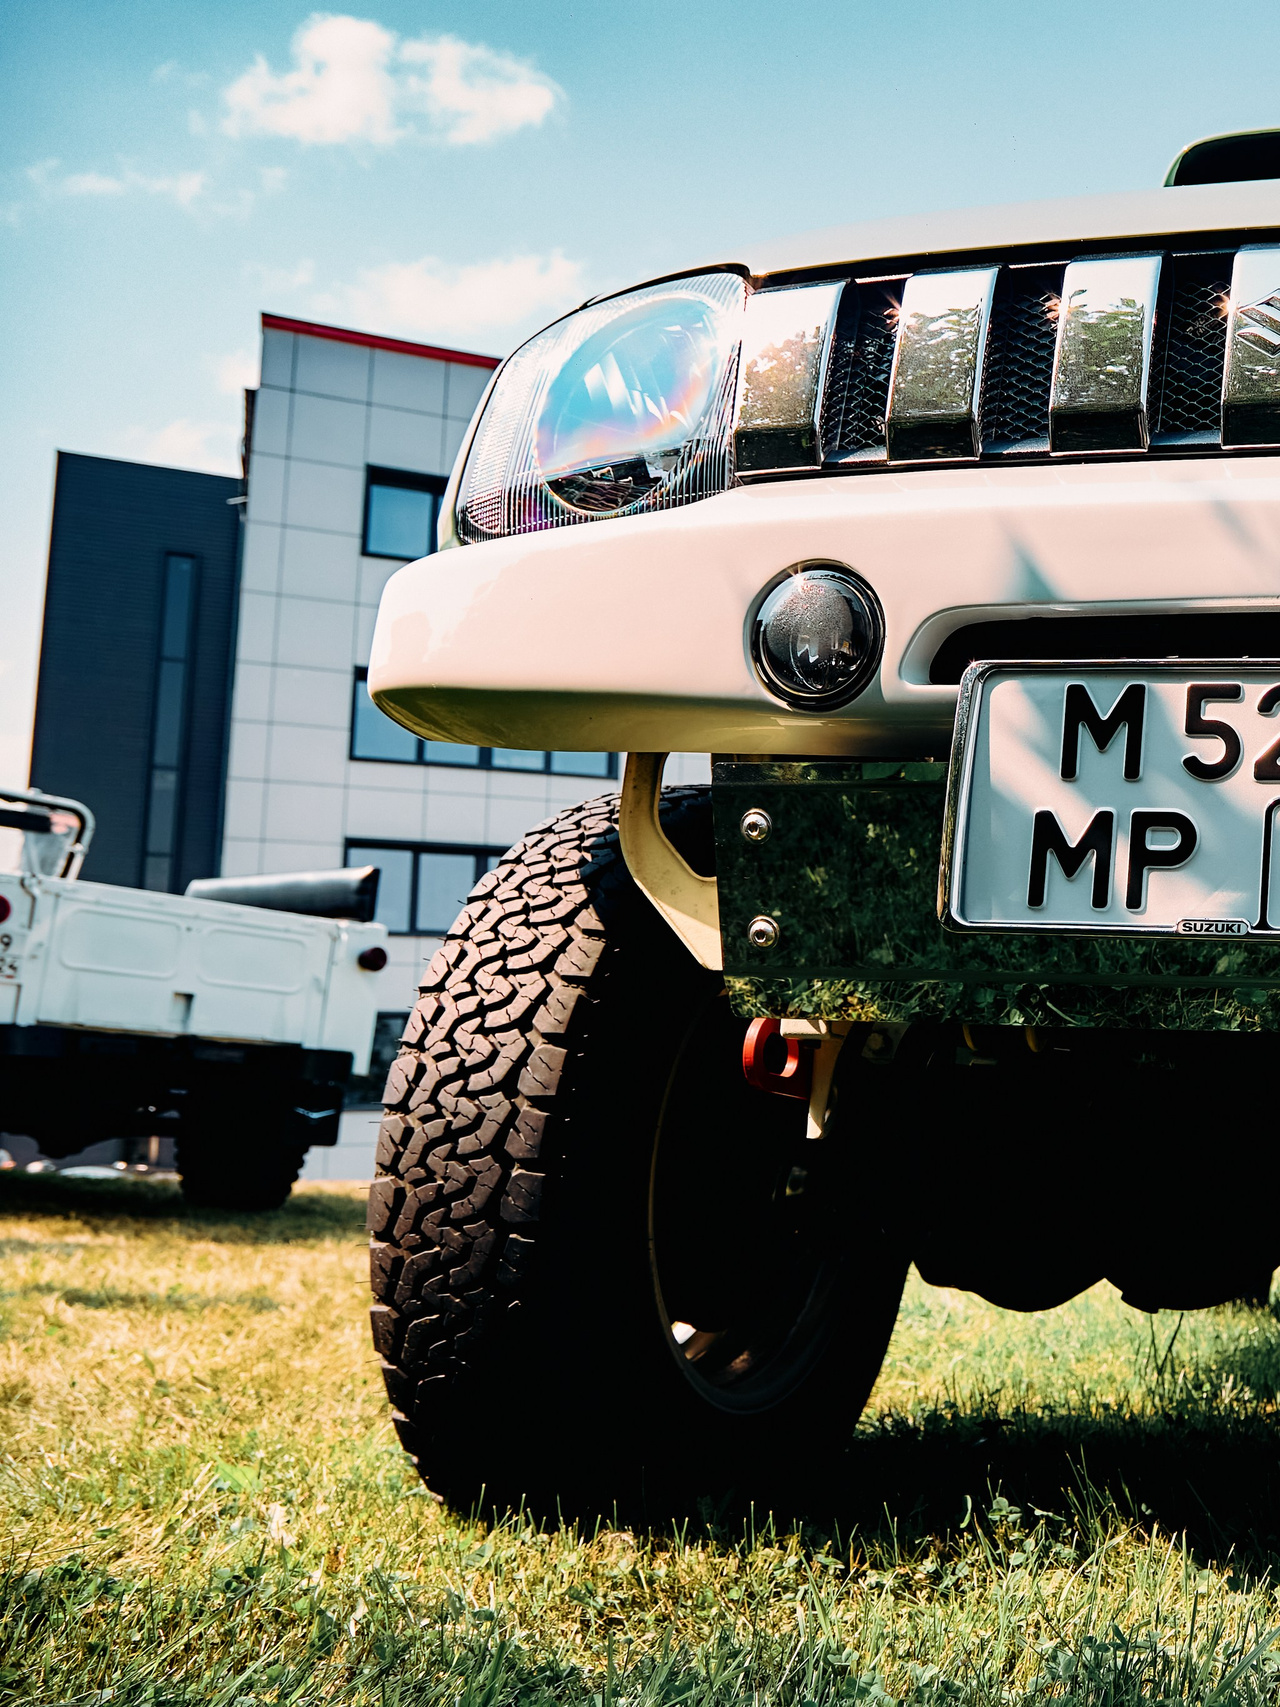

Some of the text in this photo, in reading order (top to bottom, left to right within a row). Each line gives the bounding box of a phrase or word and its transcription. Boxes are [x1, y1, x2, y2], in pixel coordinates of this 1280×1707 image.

[1060, 683, 1146, 783] M
[1027, 810, 1198, 910] MP
[1182, 922, 1241, 934] SUZUKI
